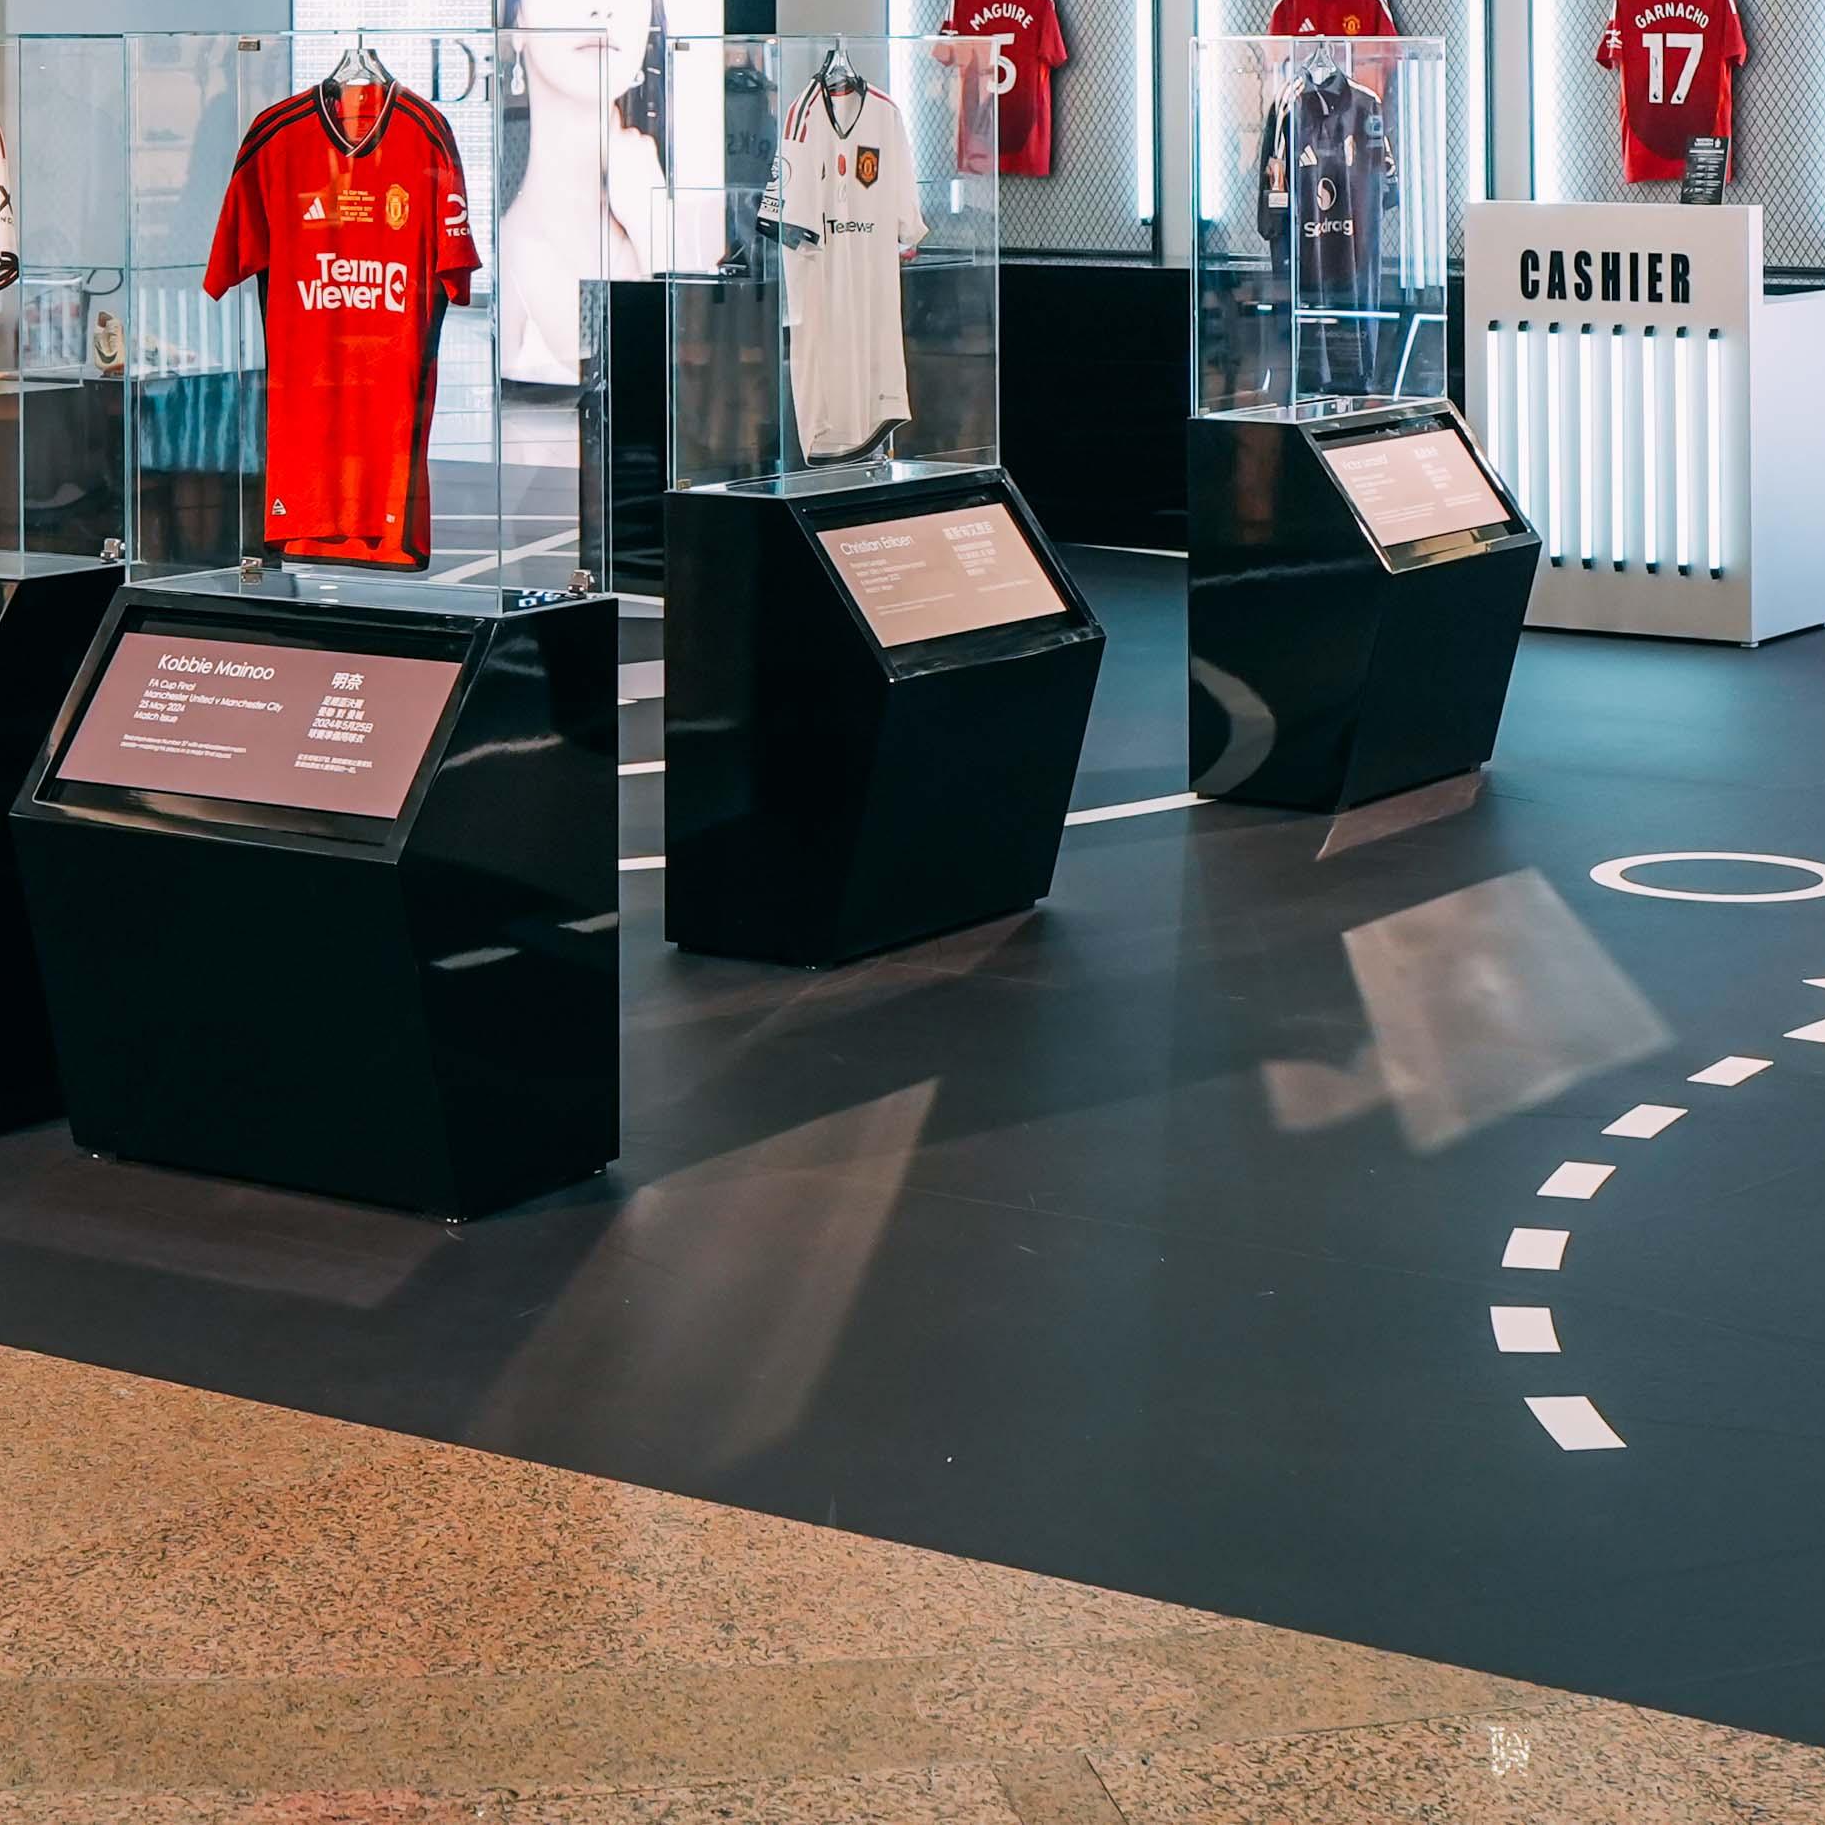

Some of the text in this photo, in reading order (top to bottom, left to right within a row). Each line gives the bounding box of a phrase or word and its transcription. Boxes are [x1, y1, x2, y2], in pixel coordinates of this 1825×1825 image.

[969, 2, 1035, 32] MAGUIRE
[1634, 1, 1711, 30] GARNACHO
[1641, 32, 1705, 106] 17
[1518, 248, 1692, 305] CASHIER
[157, 653, 275, 681] Kobbie Mainoo
[148, 678, 196, 691] FA Cup Final
[143, 689, 190, 703] Manchester
[189, 693, 216, 705] United
[221, 697, 267, 711] Manchester
[267, 701, 285, 713] City
[149, 700, 167, 712] May
[167, 702, 186, 713] 2024
[133, 710, 159, 721] Match
